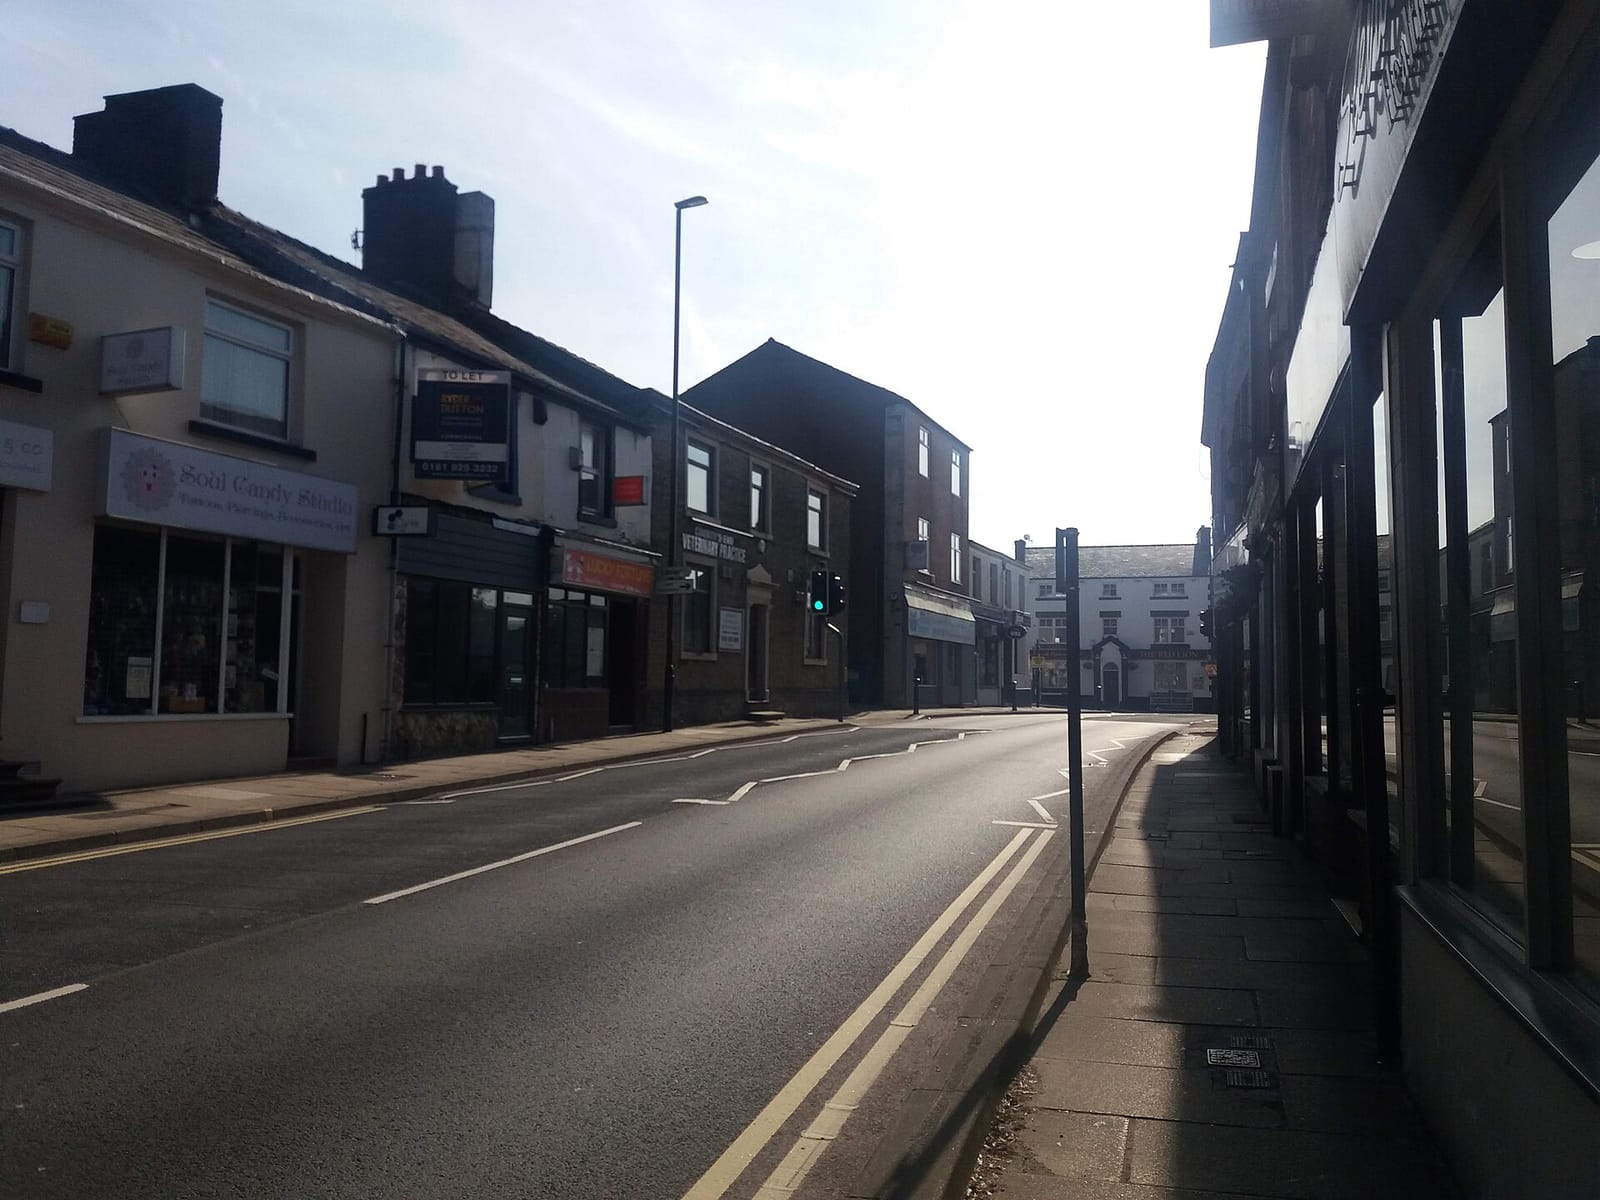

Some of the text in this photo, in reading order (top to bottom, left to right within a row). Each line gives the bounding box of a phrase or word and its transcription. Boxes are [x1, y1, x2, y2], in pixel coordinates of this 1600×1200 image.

[443, 370, 483, 380] TO LET
[179, 464, 353, 515] Soul Candy Studio
[682, 532, 746, 563] VETERINARY PRACTICE
